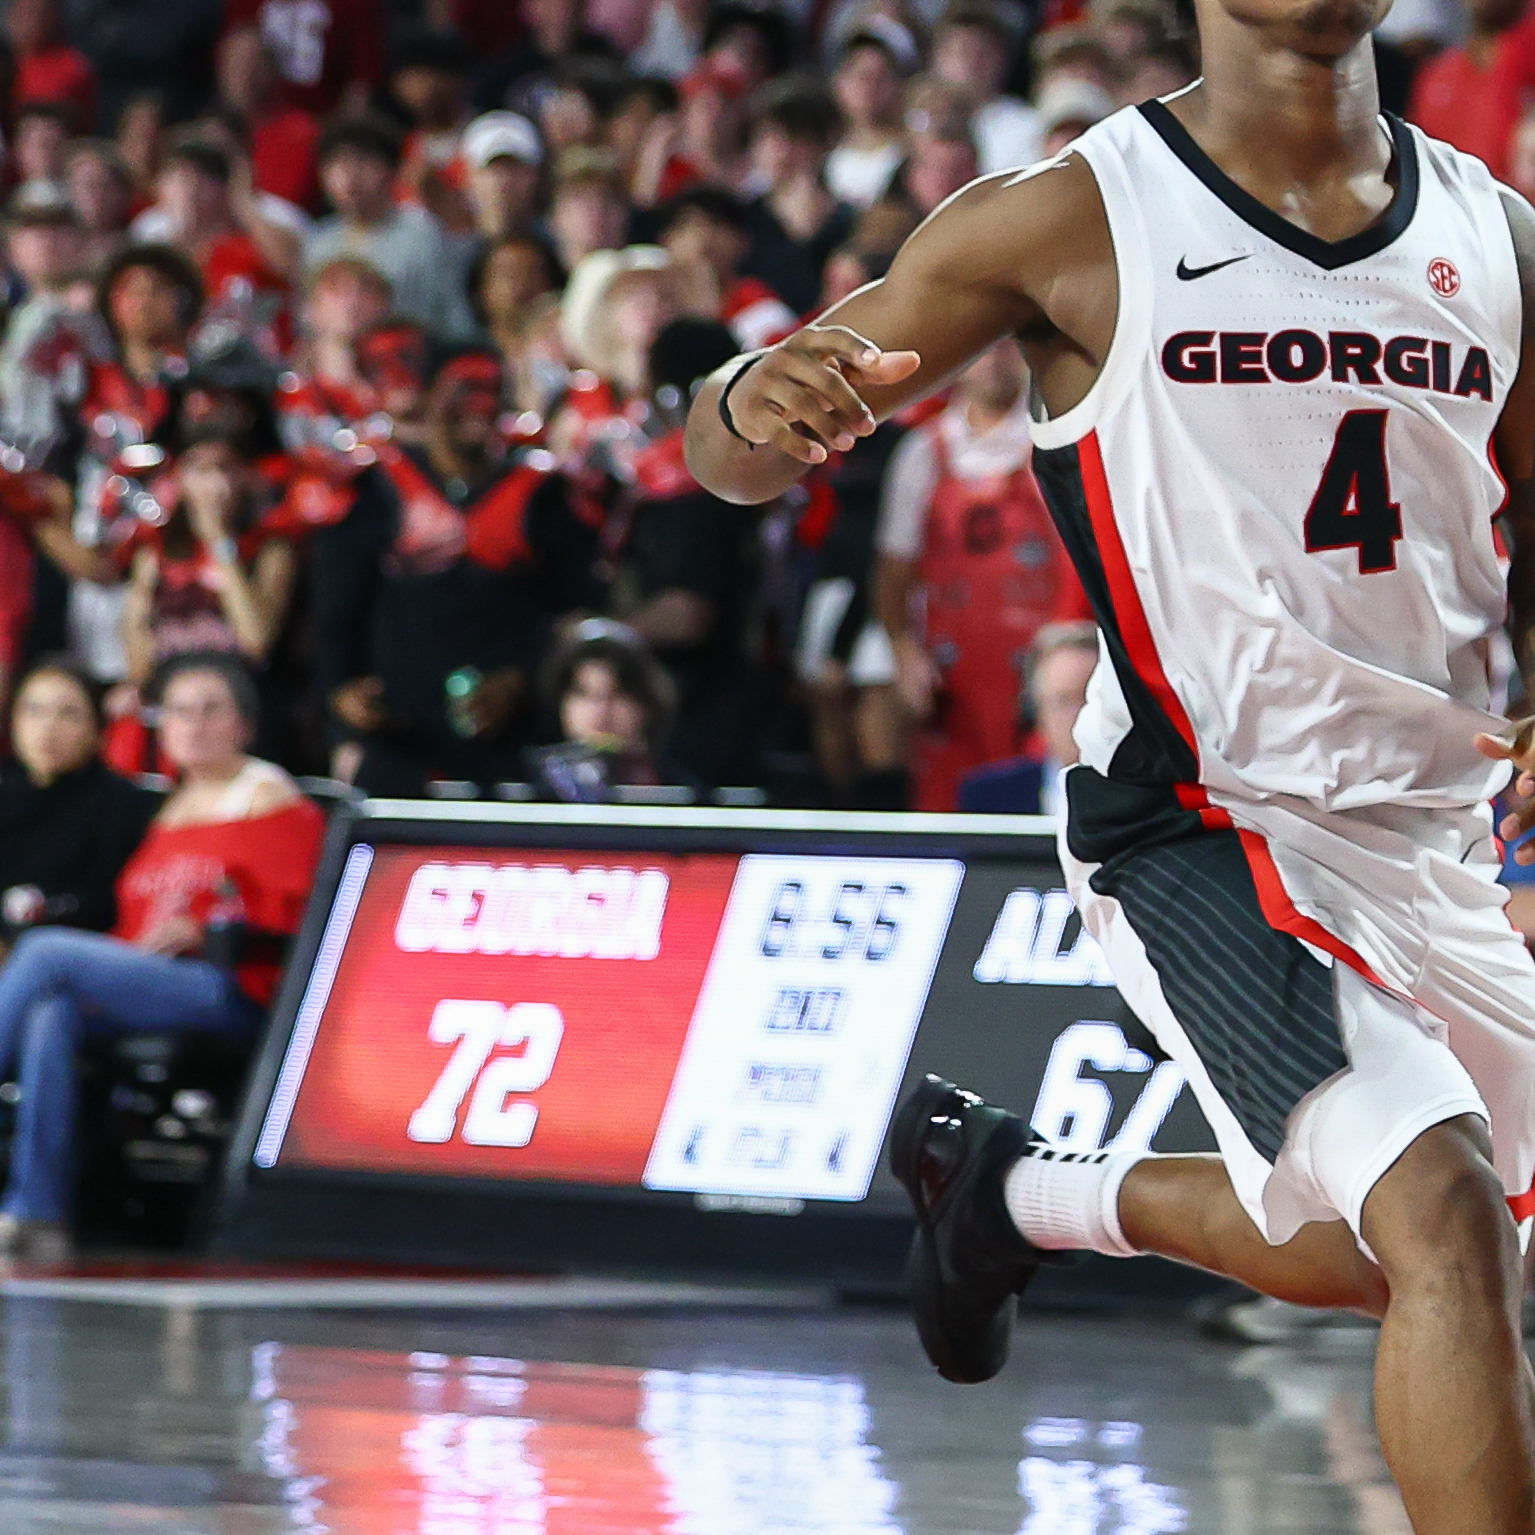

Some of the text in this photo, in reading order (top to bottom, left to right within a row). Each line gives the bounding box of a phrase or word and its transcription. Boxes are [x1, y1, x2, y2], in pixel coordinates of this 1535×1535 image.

[1162, 329, 1494, 402] GEORGIA
[1304, 409, 1402, 575] 4
[408, 1000, 563, 1147] 72
